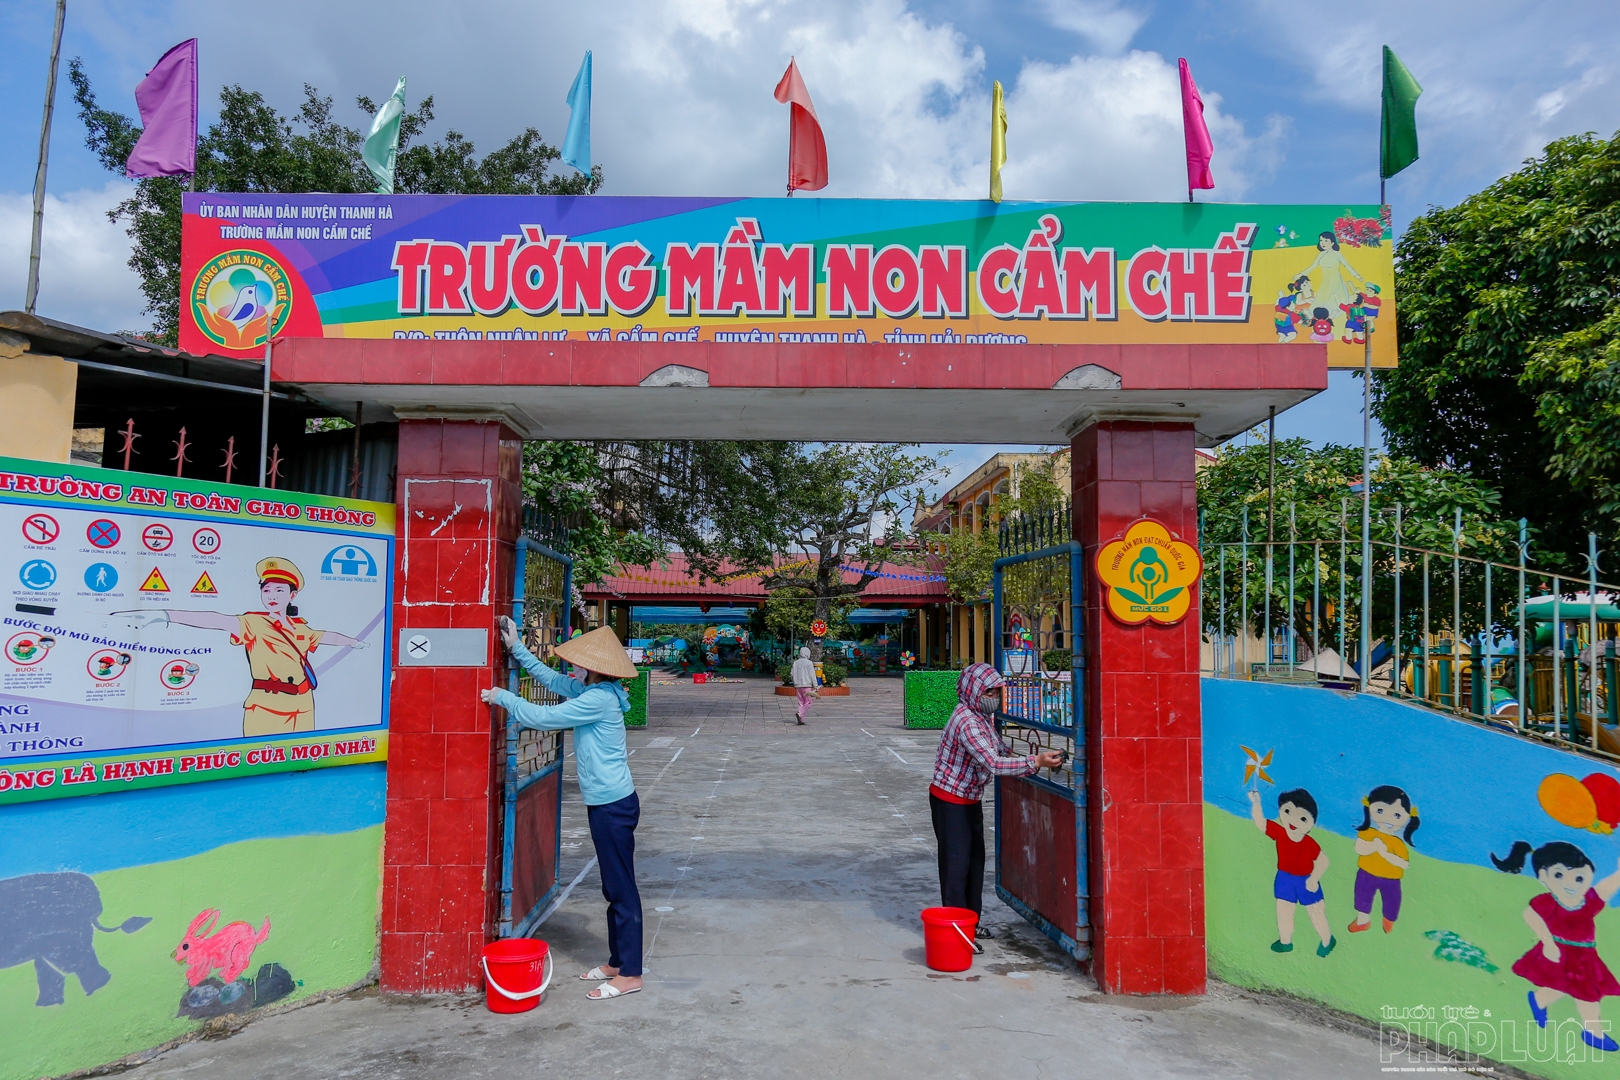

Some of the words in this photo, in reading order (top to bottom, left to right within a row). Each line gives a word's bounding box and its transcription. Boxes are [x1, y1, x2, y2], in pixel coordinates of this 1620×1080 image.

[200, 201, 213, 218] ỦY
[217, 206, 240, 218] BAN
[242, 204, 273, 218] NHÂN
[276, 204, 298, 218] DÂN
[302, 204, 337, 221] HUYỆN
[340, 207, 375, 219] THANH
[378, 205, 393, 219] HÀ
[220, 223, 263, 239] TRƯỜNG
[266, 223, 294, 239] MẦM
[297, 227, 320, 239] NON
[323, 222, 347, 239] CẨM
[351, 223, 372, 240] CHẾ
[244, 255, 264, 267] NON
[390, 224, 658, 316] TRƯỜNG
[662, 217, 815, 316] MẦM
[822, 244, 967, 317] NON
[976, 214, 1116, 319] CẨM
[1124, 223, 1257, 320] CHẾ
[0, 473, 122, 500] TRƯỜNG
[128, 488, 166, 505] AN
[173, 492, 240, 512] TOÀN
[246, 500, 300, 517] GIAO
[305, 506, 375, 525] THÔNG
[199, 536, 214, 546] 20
[3, 618, 40, 631] BƯỚC
[43, 625, 66, 636] ĐỘI
[69, 630, 90, 642] MŨ
[92, 636, 117, 647] BẢO
[119, 640, 147, 652] HIỂM
[149, 646, 181, 655] ĐÚNG
[183, 646, 211, 655] CÁCH
[7, 736, 83, 752] THÔNG
[62, 764, 96, 785] LÀ
[104, 758, 174, 782] HẠNH
[179, 750, 240, 774] PHÚC
[246, 746, 285, 765] CỦA
[291, 743, 330, 761] MỌI
[335, 738, 376, 756] NHÀ!
[529, 960, 542, 972] 31A
